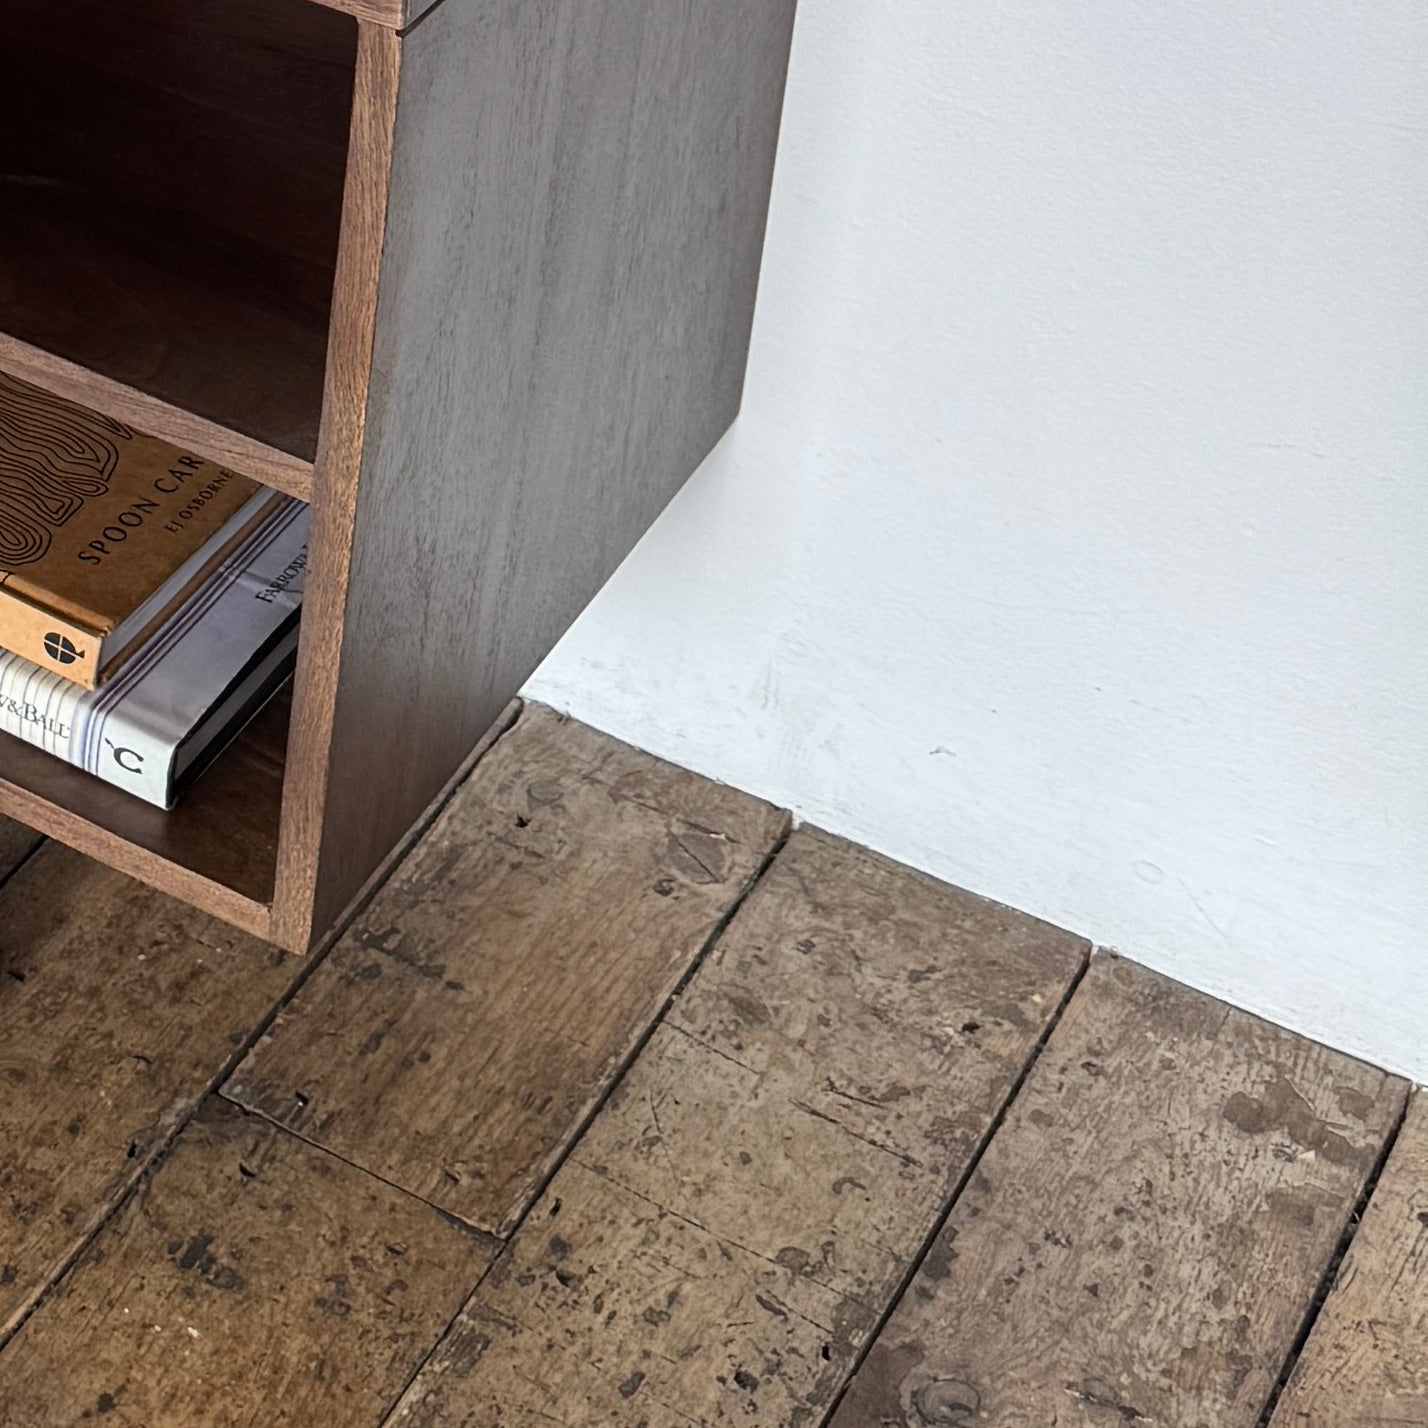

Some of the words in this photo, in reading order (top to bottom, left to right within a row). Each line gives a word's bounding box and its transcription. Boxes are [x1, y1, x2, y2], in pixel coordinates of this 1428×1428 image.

[77, 496, 160, 566] SPOON
[163, 520, 185, 534] EJ
[179, 468, 235, 520] OSBORNE
[255, 545, 309, 604] FARROW
